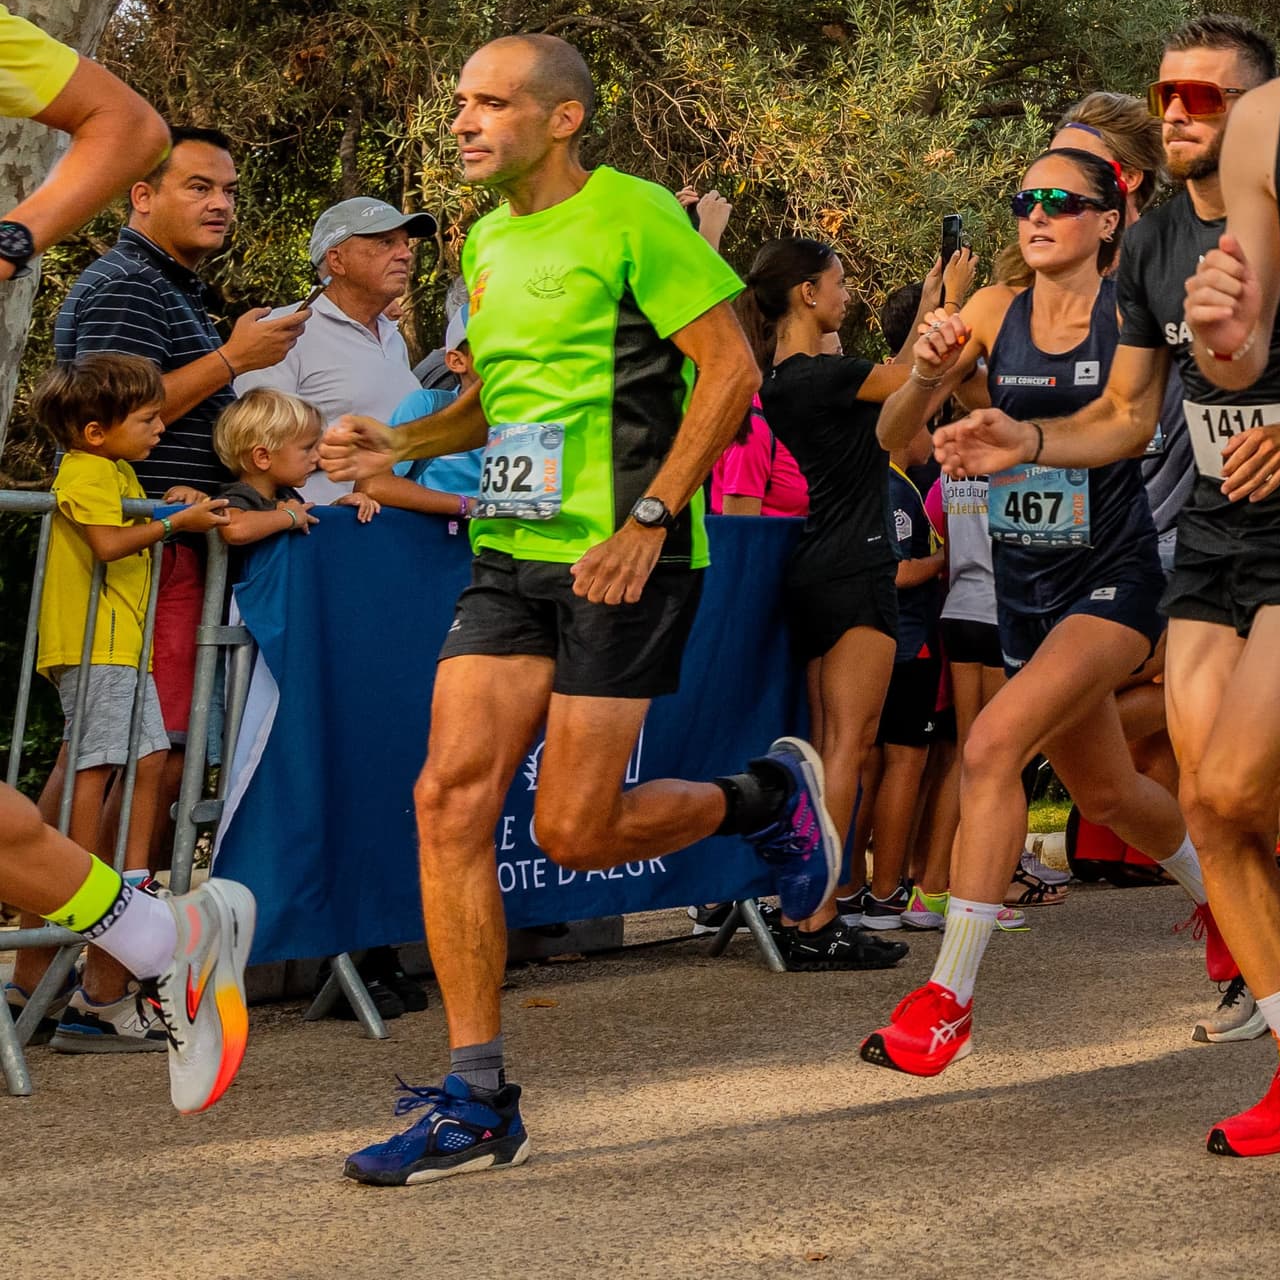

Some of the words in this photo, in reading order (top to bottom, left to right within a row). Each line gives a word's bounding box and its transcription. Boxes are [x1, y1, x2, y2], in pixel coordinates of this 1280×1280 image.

[482, 456, 533, 493] 532
[1004, 491, 1064, 525] 467
[497, 858, 547, 893] OTE
